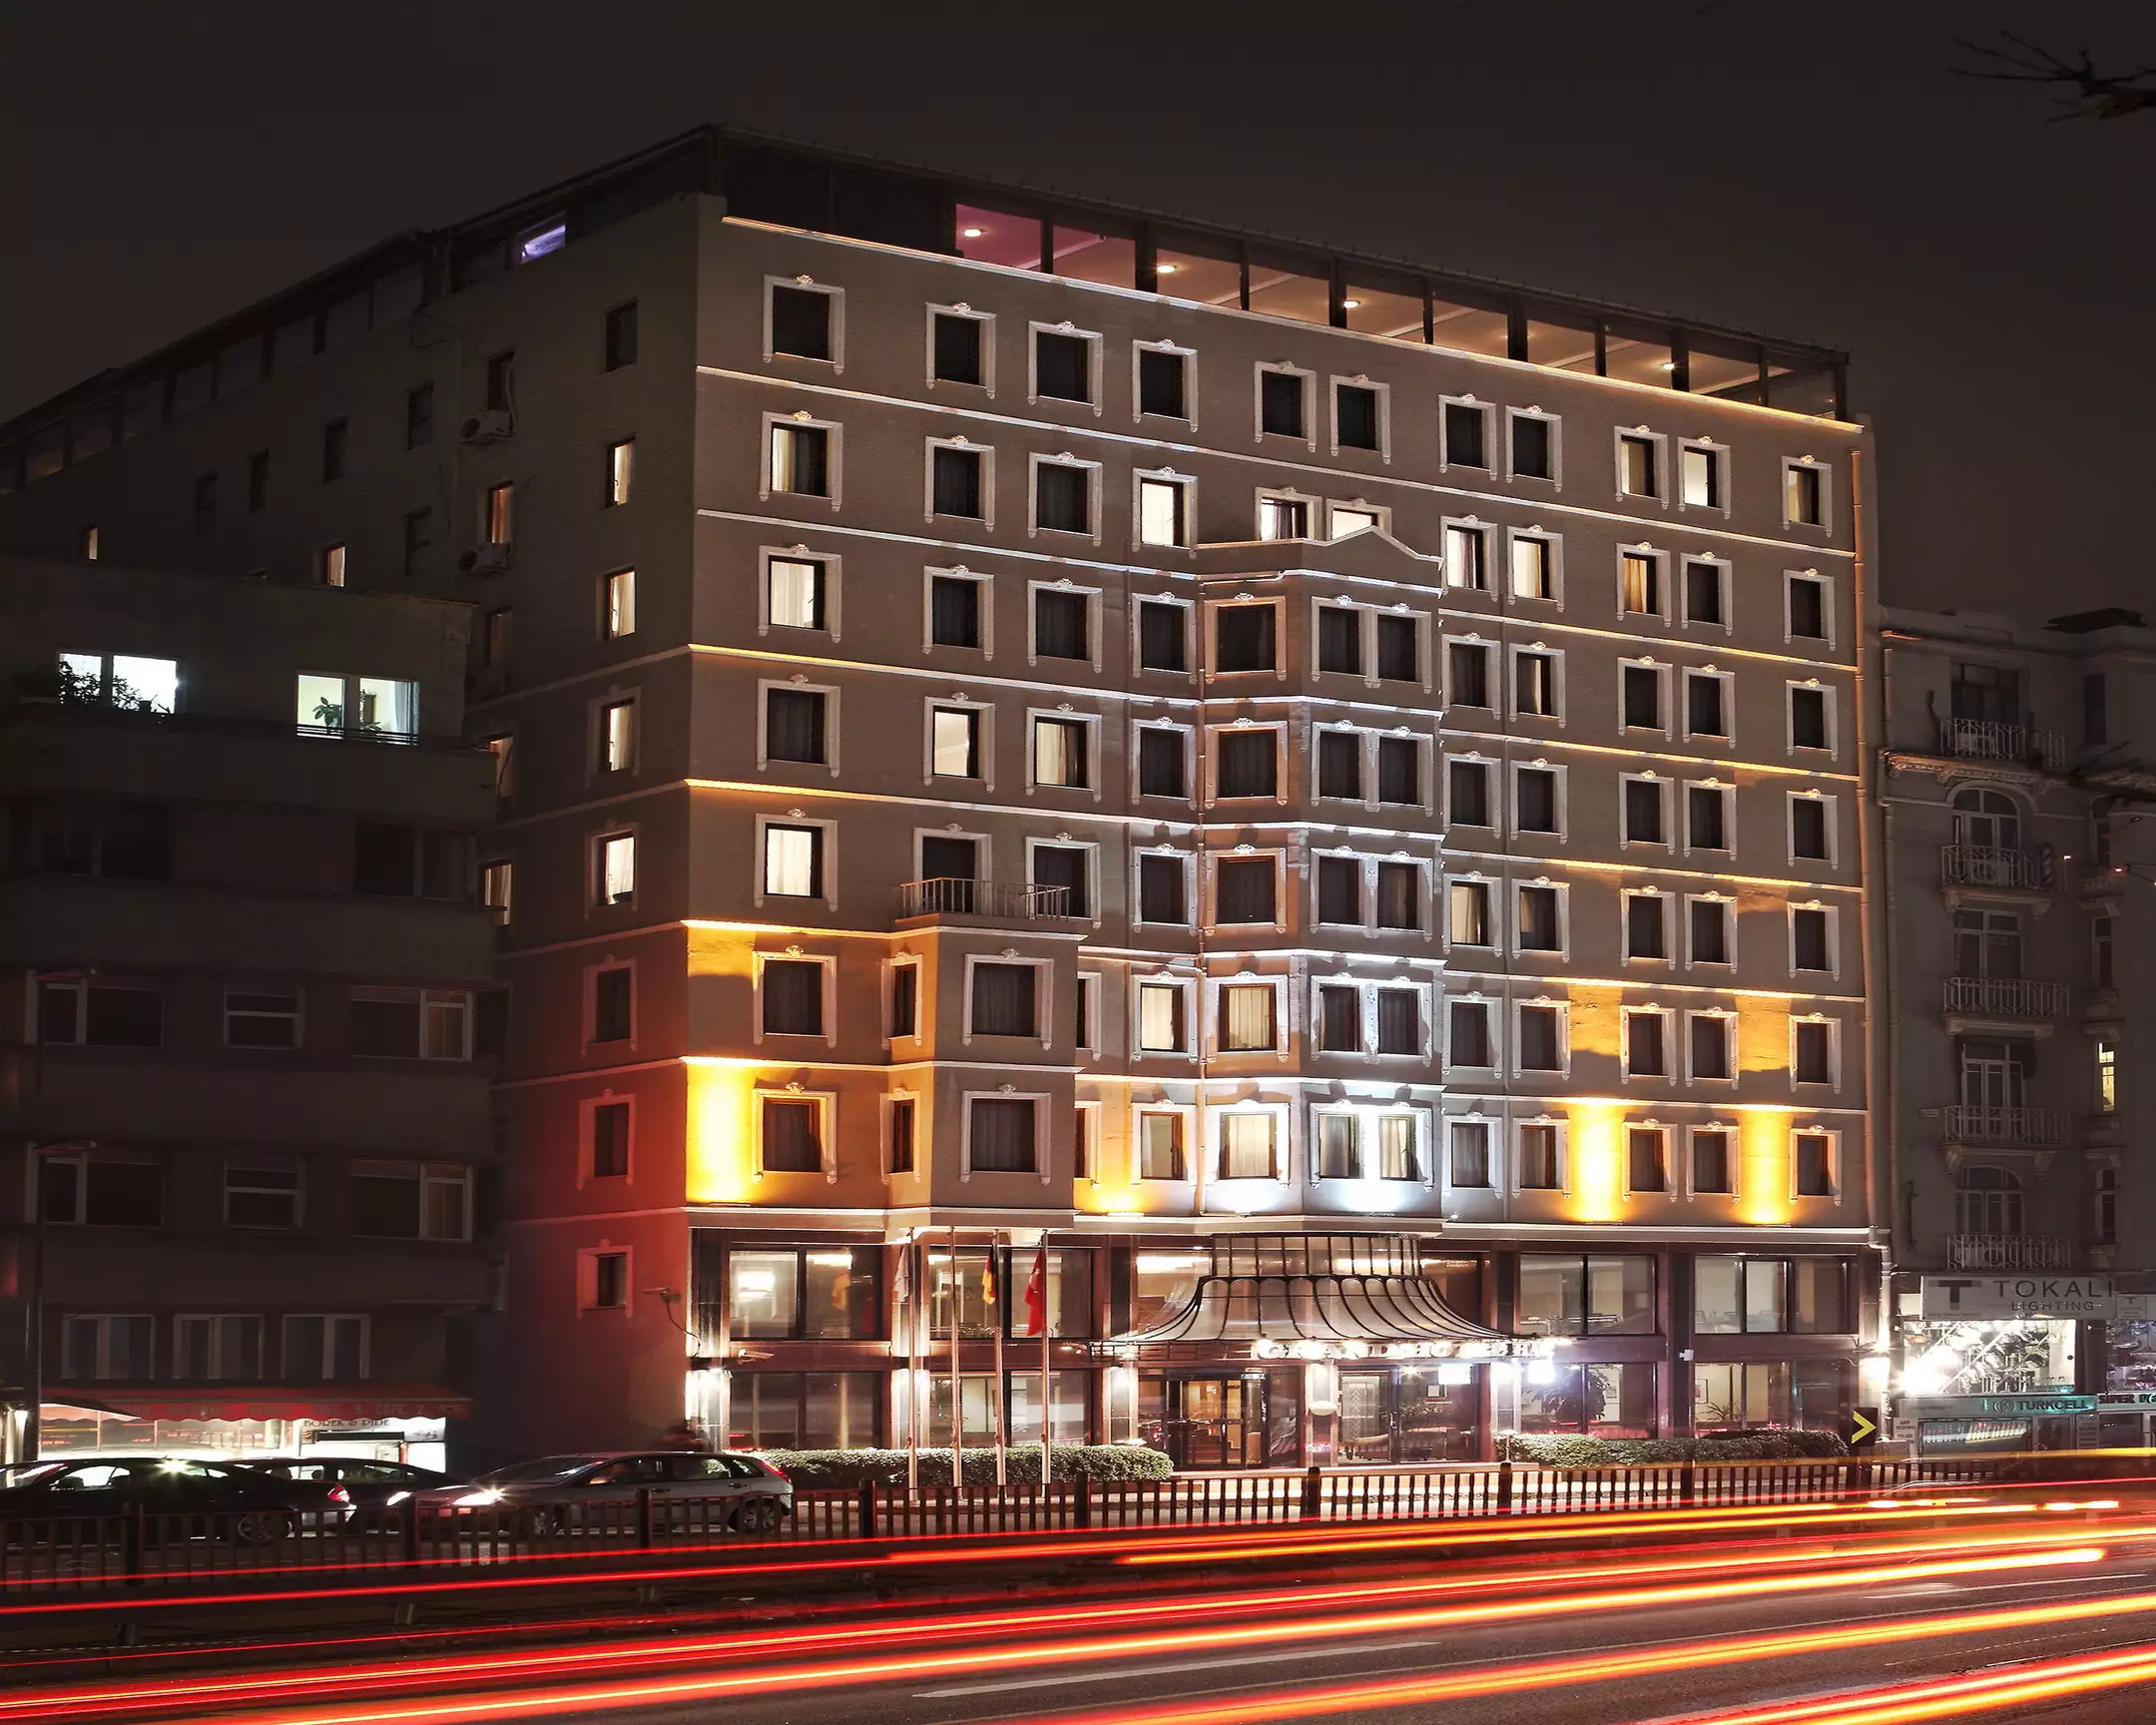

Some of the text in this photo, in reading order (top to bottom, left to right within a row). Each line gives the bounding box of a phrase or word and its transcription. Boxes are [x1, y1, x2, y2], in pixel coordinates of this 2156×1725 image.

[1993, 1280, 2112, 1298] TOKALI
[2011, 1301, 2094, 1312] LIGHTING
[2019, 1399, 2090, 1411] TURKCELL
